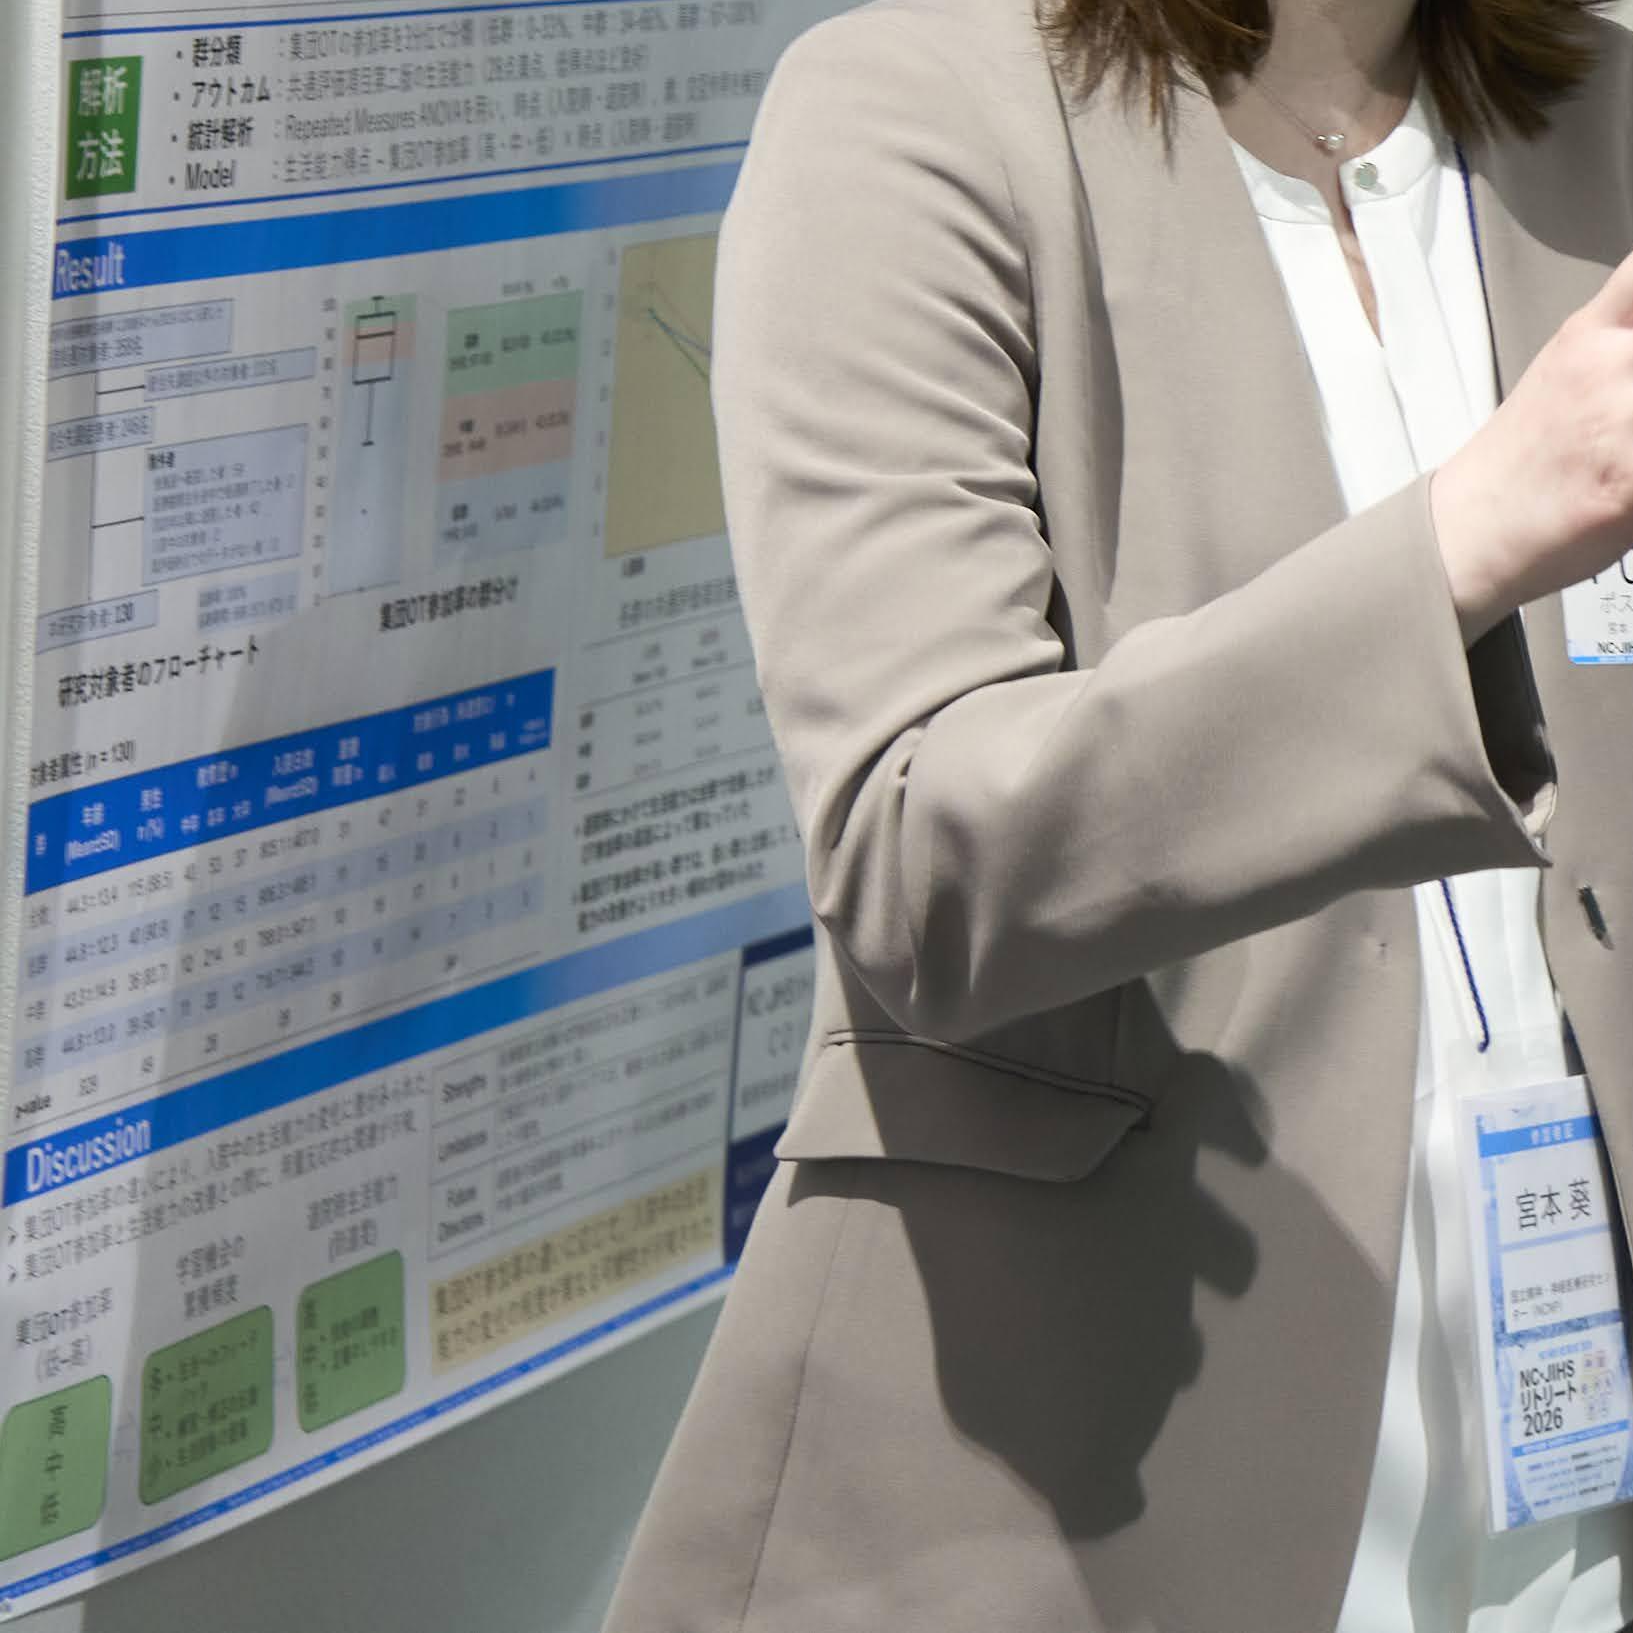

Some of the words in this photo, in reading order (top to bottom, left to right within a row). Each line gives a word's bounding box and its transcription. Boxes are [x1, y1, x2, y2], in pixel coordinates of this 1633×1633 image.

[76, 64, 129, 118] 解析
[191, 76, 272, 109] アウトカム
[76, 130, 126, 182] 方法
[184, 160, 237, 191] Model
[55, 240, 127, 294] Result
[57, 634, 260, 710] 研究対象者のフローチャート
[25, 1116, 152, 1193] Discussion
[1515, 1184, 1564, 1232] 宮本
[1520, 1379, 1578, 1413] リトリート
[1523, 1407, 1564, 1438] 2026
